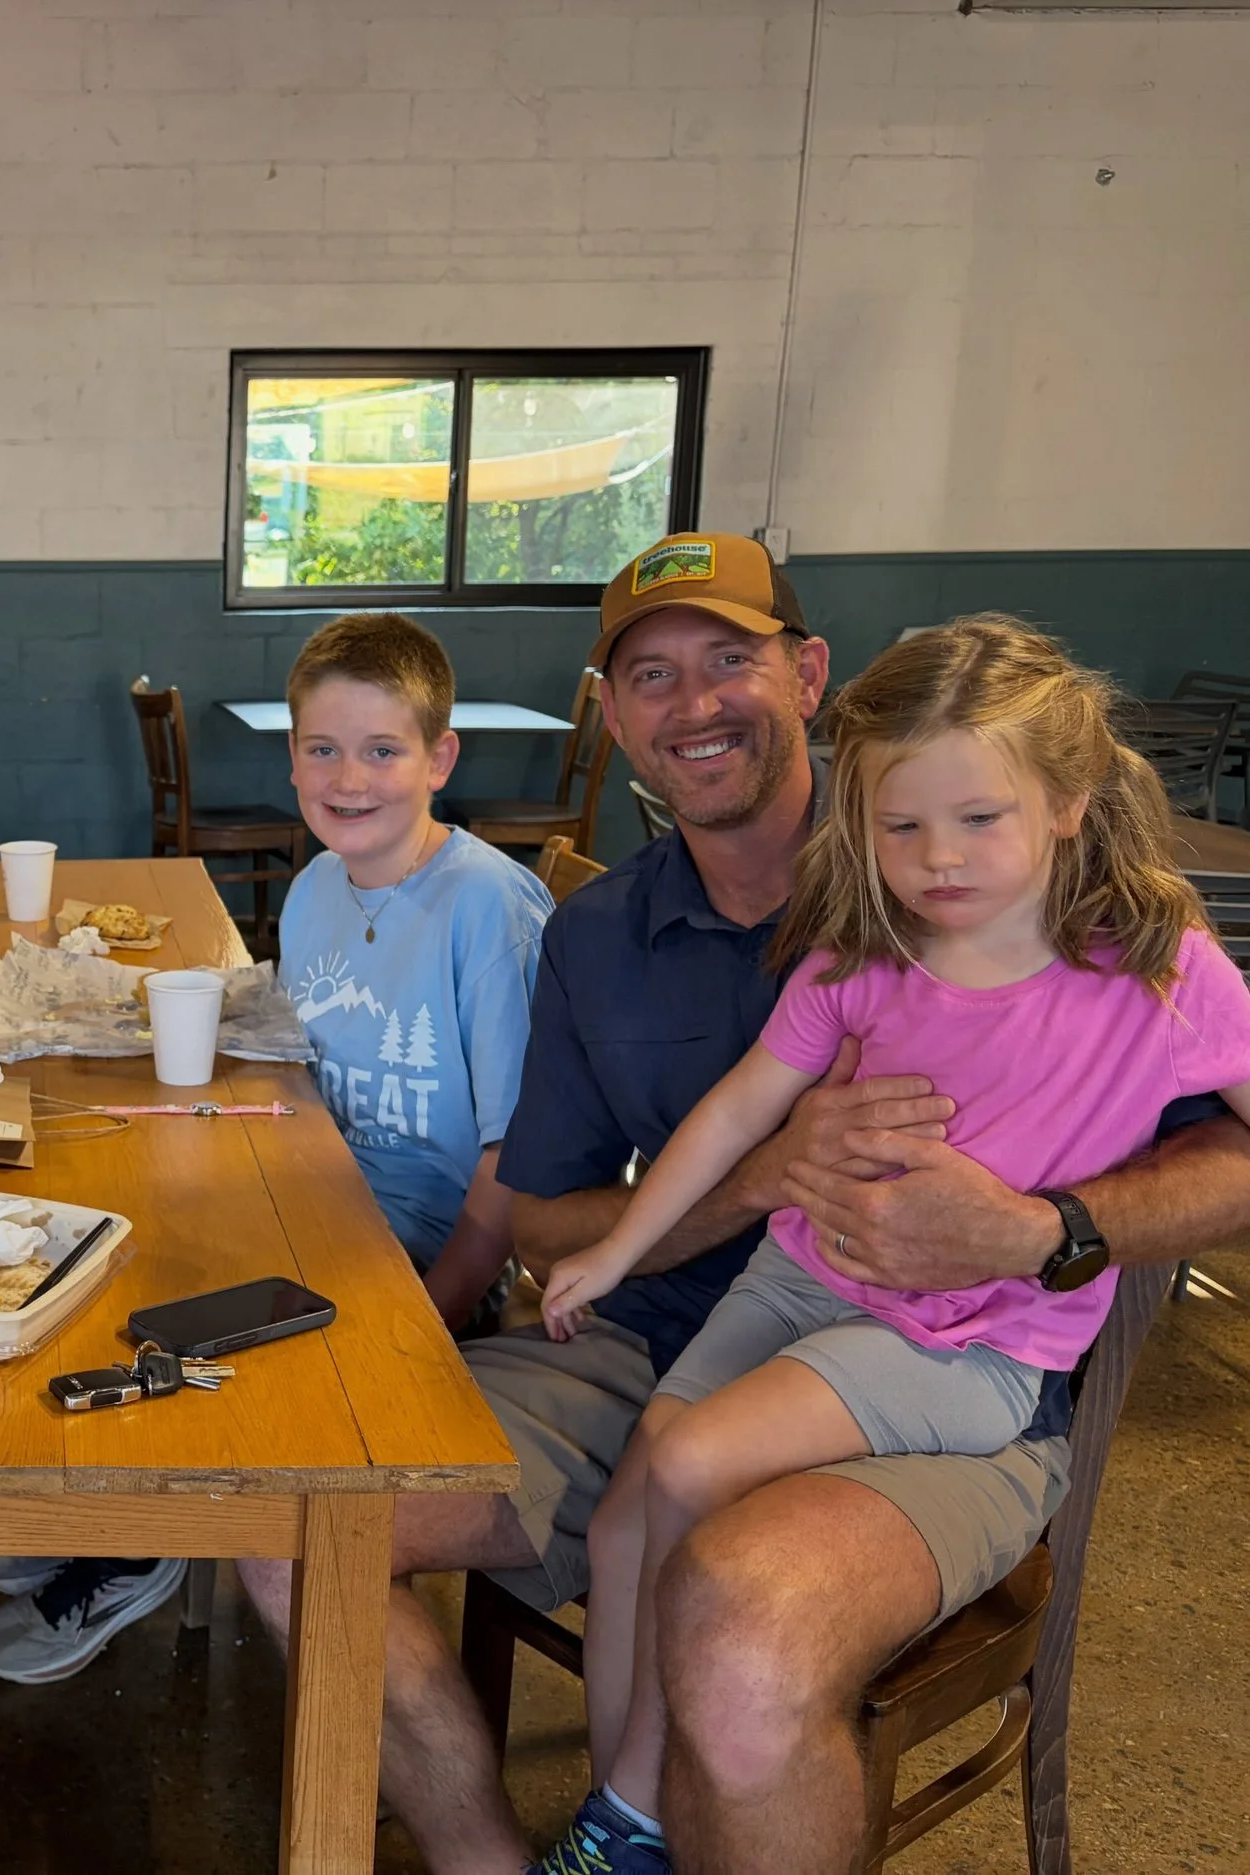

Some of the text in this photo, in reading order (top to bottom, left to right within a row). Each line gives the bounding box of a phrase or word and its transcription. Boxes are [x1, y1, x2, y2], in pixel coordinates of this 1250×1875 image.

[643, 545, 707, 564] treehouse
[318, 1059, 439, 1138] REAT
[345, 1127, 400, 1148] NVILLE
